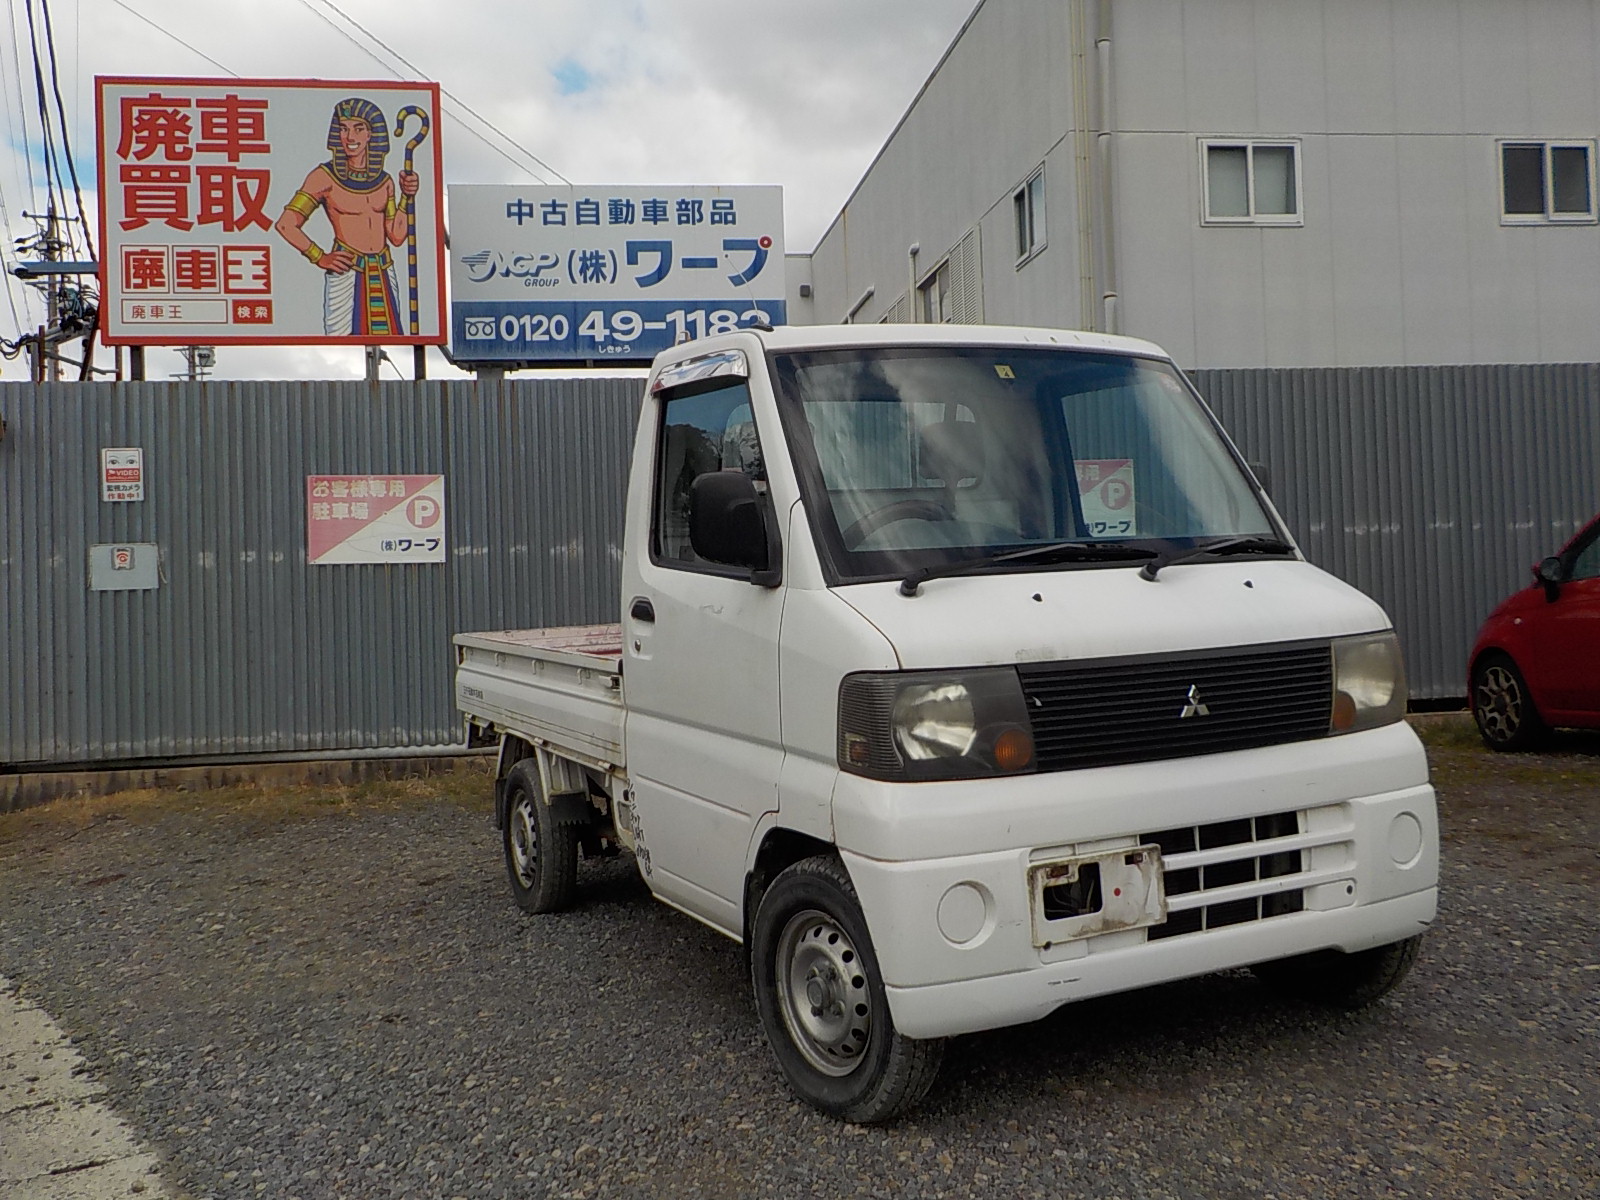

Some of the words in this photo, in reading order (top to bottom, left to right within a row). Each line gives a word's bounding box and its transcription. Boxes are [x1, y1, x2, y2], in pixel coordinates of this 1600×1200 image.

[116, 93, 271, 163] 廃車
[119, 165, 273, 233] 買取
[506, 197, 737, 226] 中古自動車部品
[124, 246, 270, 292] 廃車王
[524, 278, 560, 288] GROUP
[131, 305, 183, 319] 廃車王
[237, 305, 268, 318] 検索
[499, 314, 569, 342] 0120
[598, 345, 631, 354] しきゅう
[312, 479, 406, 498] お客様専用
[1108, 482, 1125, 507] P
[312, 502, 369, 520] 駐車場
[414, 499, 435, 525] P
[381, 537, 441, 552] (株)ワープ
